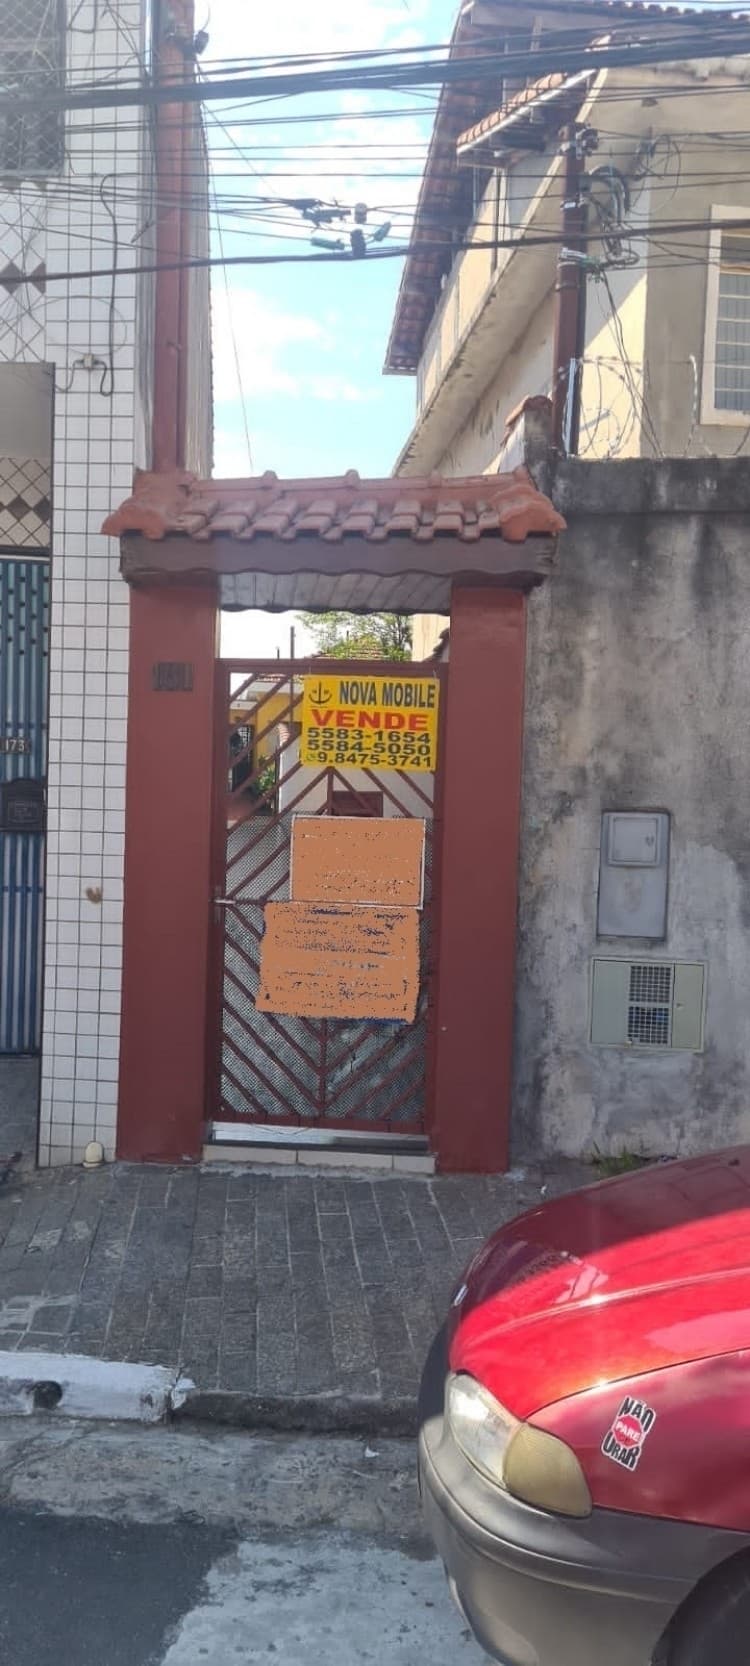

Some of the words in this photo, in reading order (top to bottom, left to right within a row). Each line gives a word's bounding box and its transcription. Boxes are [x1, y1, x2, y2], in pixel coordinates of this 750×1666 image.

[340, 680, 377, 706] NOVA
[382, 682, 436, 709] MOBILE
[311, 709, 430, 731] VENDE
[307, 727, 431, 744] 5583-1654
[6, 738, 25, 752] 173
[307, 739, 431, 757] 5584-5050
[317, 751, 431, 768] 9.8475-3741
[616, 1420, 641, 1442] PARE
